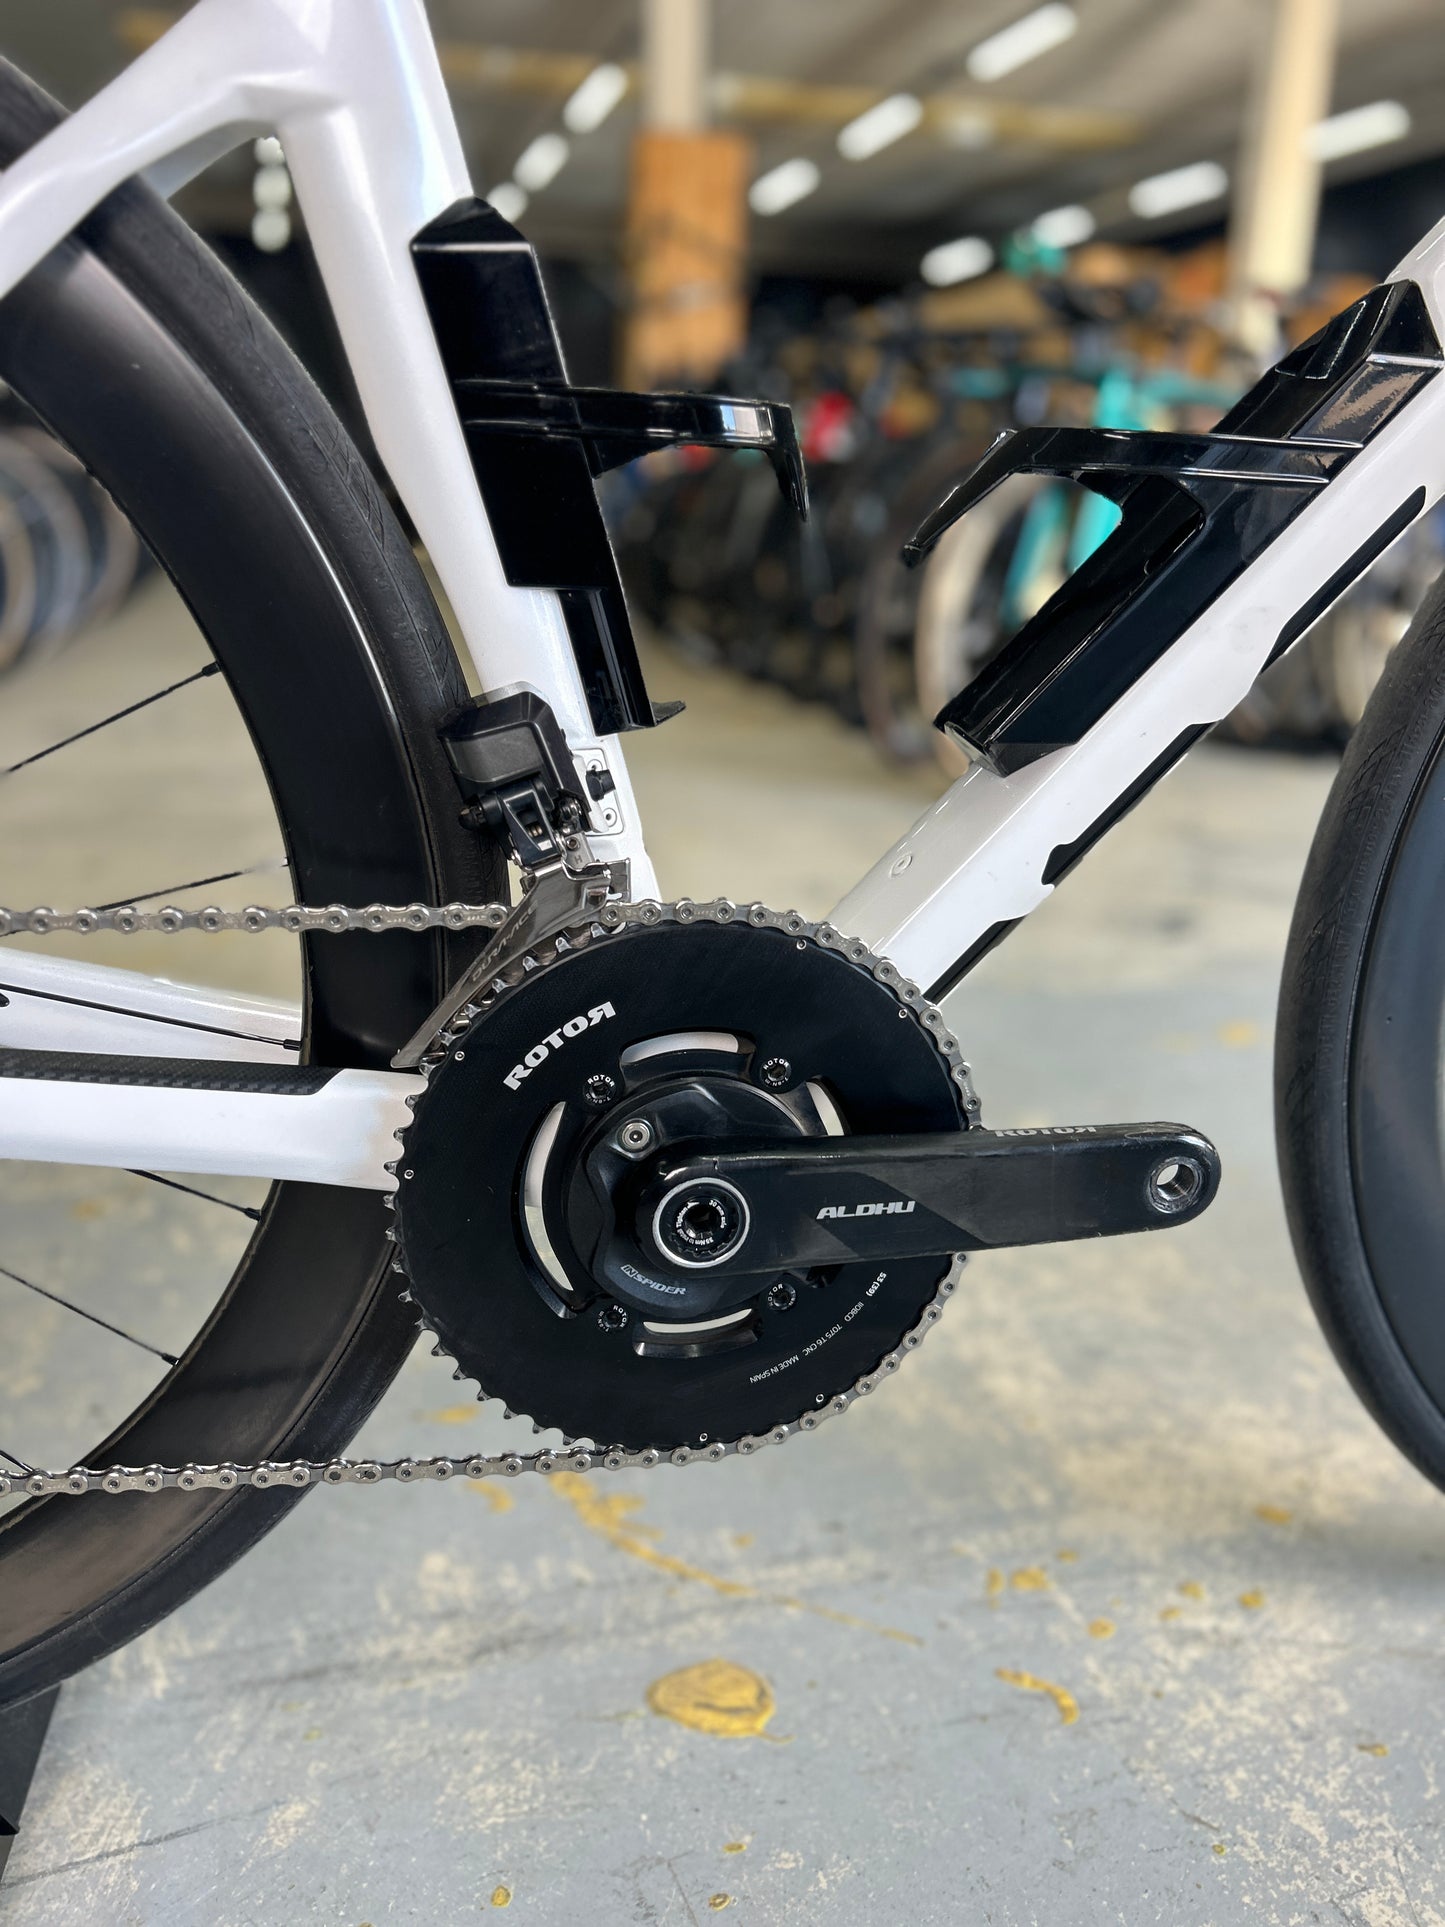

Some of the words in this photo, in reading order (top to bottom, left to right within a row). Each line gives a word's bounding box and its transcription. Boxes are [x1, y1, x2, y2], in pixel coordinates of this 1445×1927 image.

[503, 1001, 616, 1090] ROTOR
[763, 1057, 789, 1070] ROTOR
[587, 1074, 615, 1088] ROTOR
[816, 1201, 916, 1220] ALDHU
[620, 1264, 687, 1295] INSPIDER
[612, 1304, 628, 1328] ROTOR
[802, 1343, 818, 1356] CNC
[778, 1354, 800, 1370] MADE
[749, 1369, 771, 1384] SPAIN
